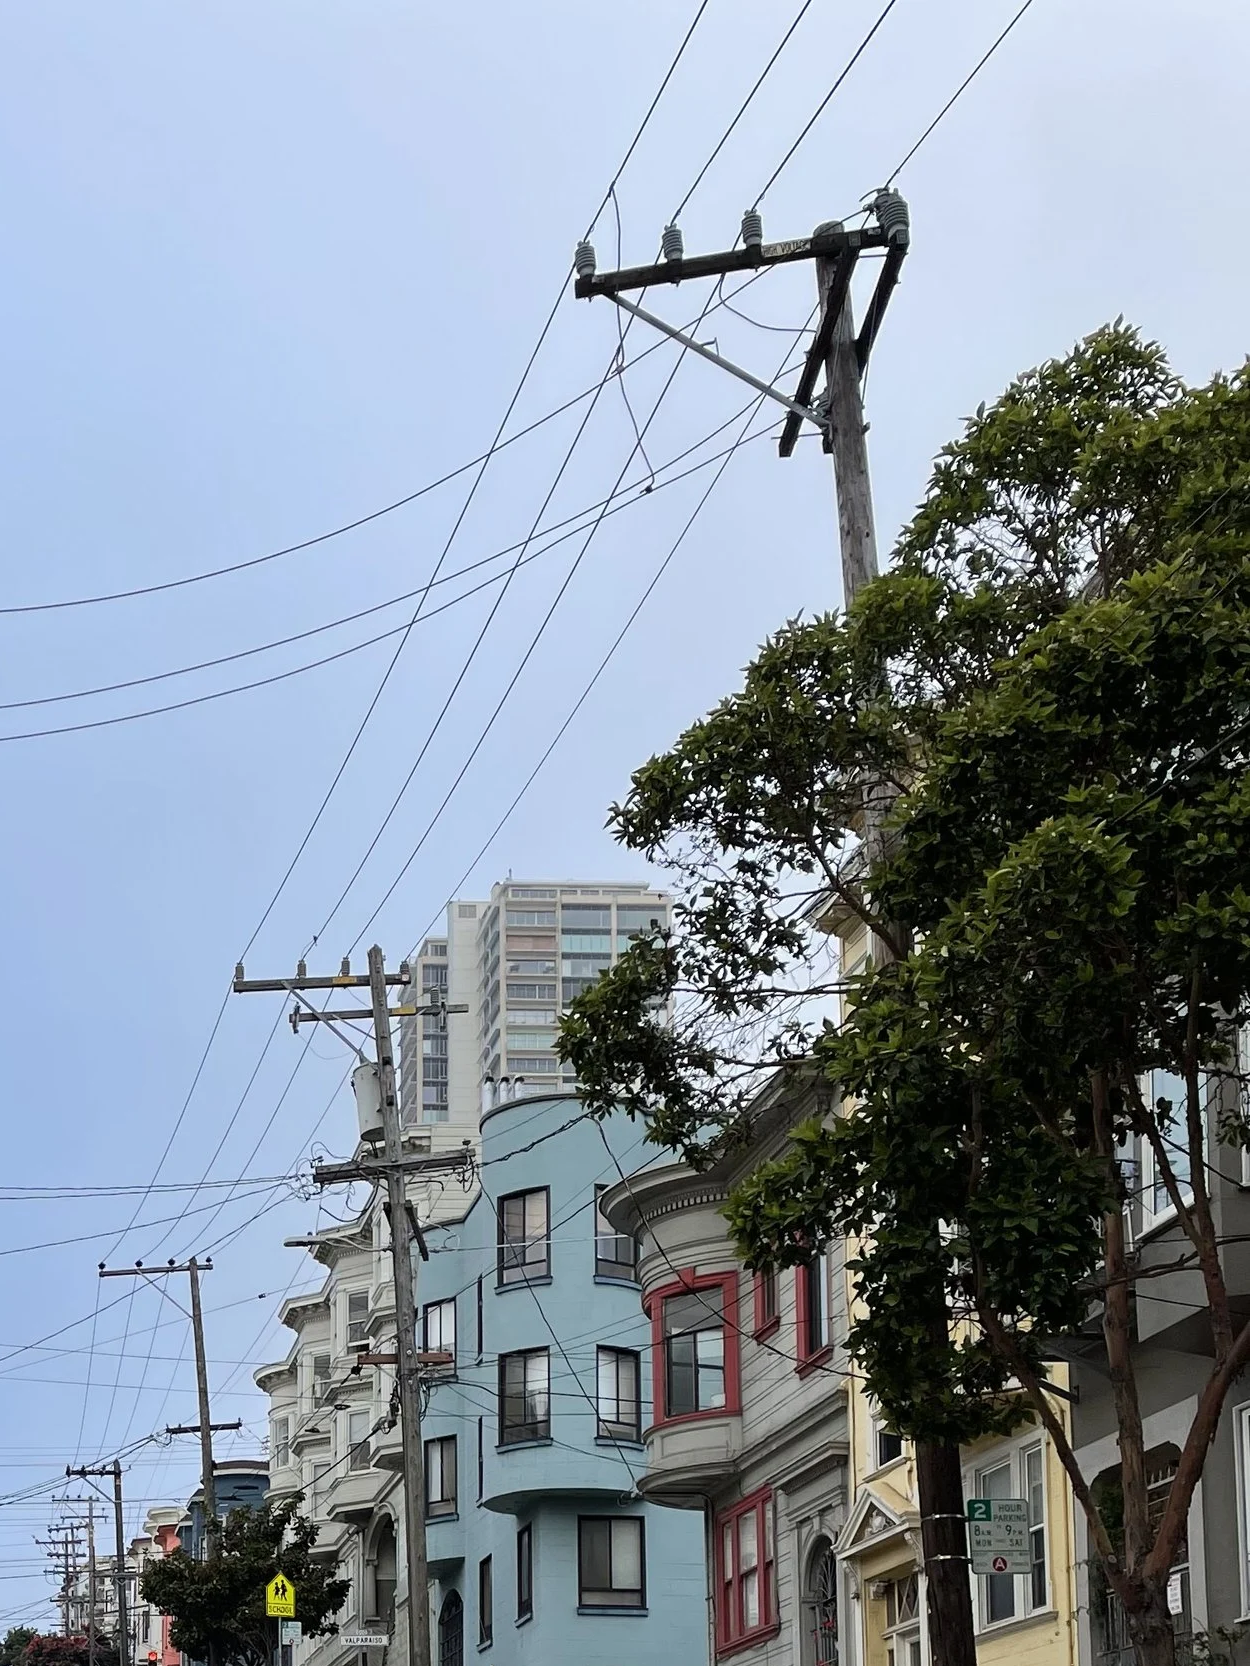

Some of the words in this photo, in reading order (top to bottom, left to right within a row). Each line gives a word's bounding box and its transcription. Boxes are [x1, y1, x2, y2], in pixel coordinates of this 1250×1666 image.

[974, 1503, 987, 1518] 2
[998, 1504, 1022, 1512] HOUR
[994, 1514, 1027, 1522] PARKING
[976, 1539, 992, 1547] MON
[1010, 1539, 1023, 1547] SAT
[995, 1557, 1006, 1569] A
[268, 1605, 293, 1614] SCHOOL
